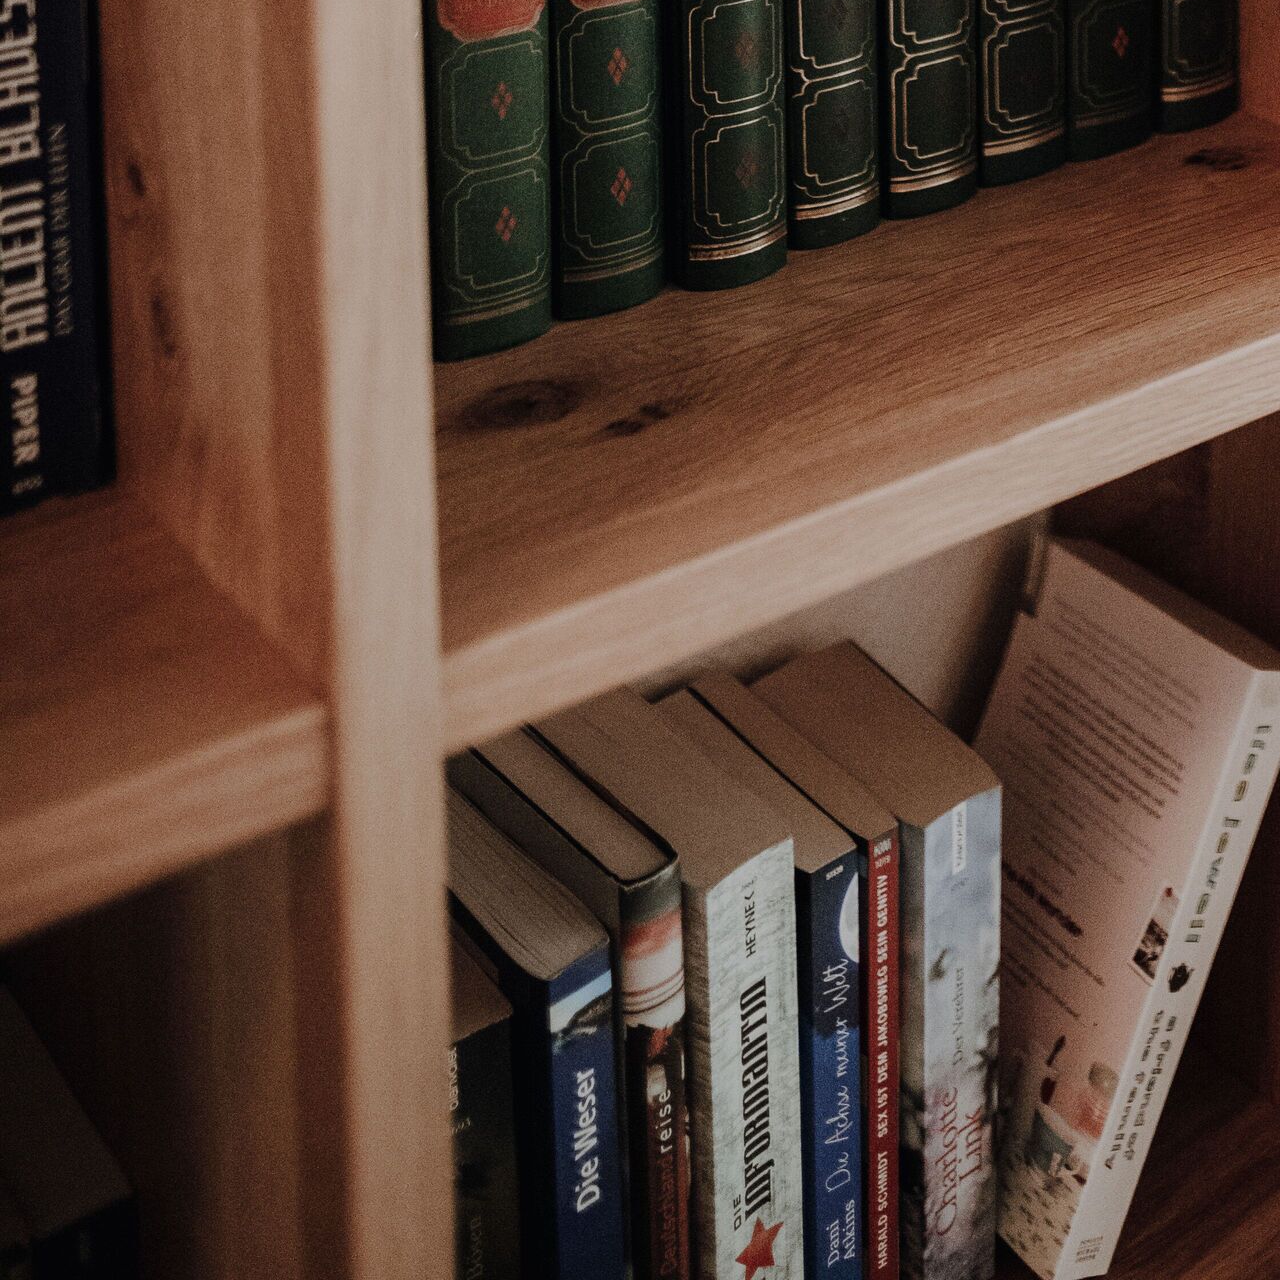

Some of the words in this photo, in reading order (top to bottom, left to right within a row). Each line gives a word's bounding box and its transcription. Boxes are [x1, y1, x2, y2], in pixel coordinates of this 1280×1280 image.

[50, 189, 70, 230] DER
[0, 180, 49, 351] ANCIENT
[50, 238, 72, 293] GRAB
[51, 297, 73, 335] DAS
[10, 373, 40, 463] PIPER
[876, 874, 888, 927] GENITIV
[743, 901, 757, 958] HEYNE
[876, 930, 888, 962] SEIN
[876, 966, 888, 1047] JAKOBSWEG
[877, 1051, 888, 1083] DEM
[573, 1067, 597, 1158] Weser
[877, 1086, 888, 1107] IST
[877, 1109, 888, 1138] SEX
[936, 1086, 960, 1237] Charlotte
[959, 1108, 984, 1185] Link
[574, 1156, 601, 1213] Die
[876, 1151, 889, 1212] SCHMIDT
[733, 1194, 742, 1231] DIE
[843, 1198, 856, 1269] Atkins
[827, 1219, 840, 1269] Dani
[876, 1214, 889, 1269] HARALD
